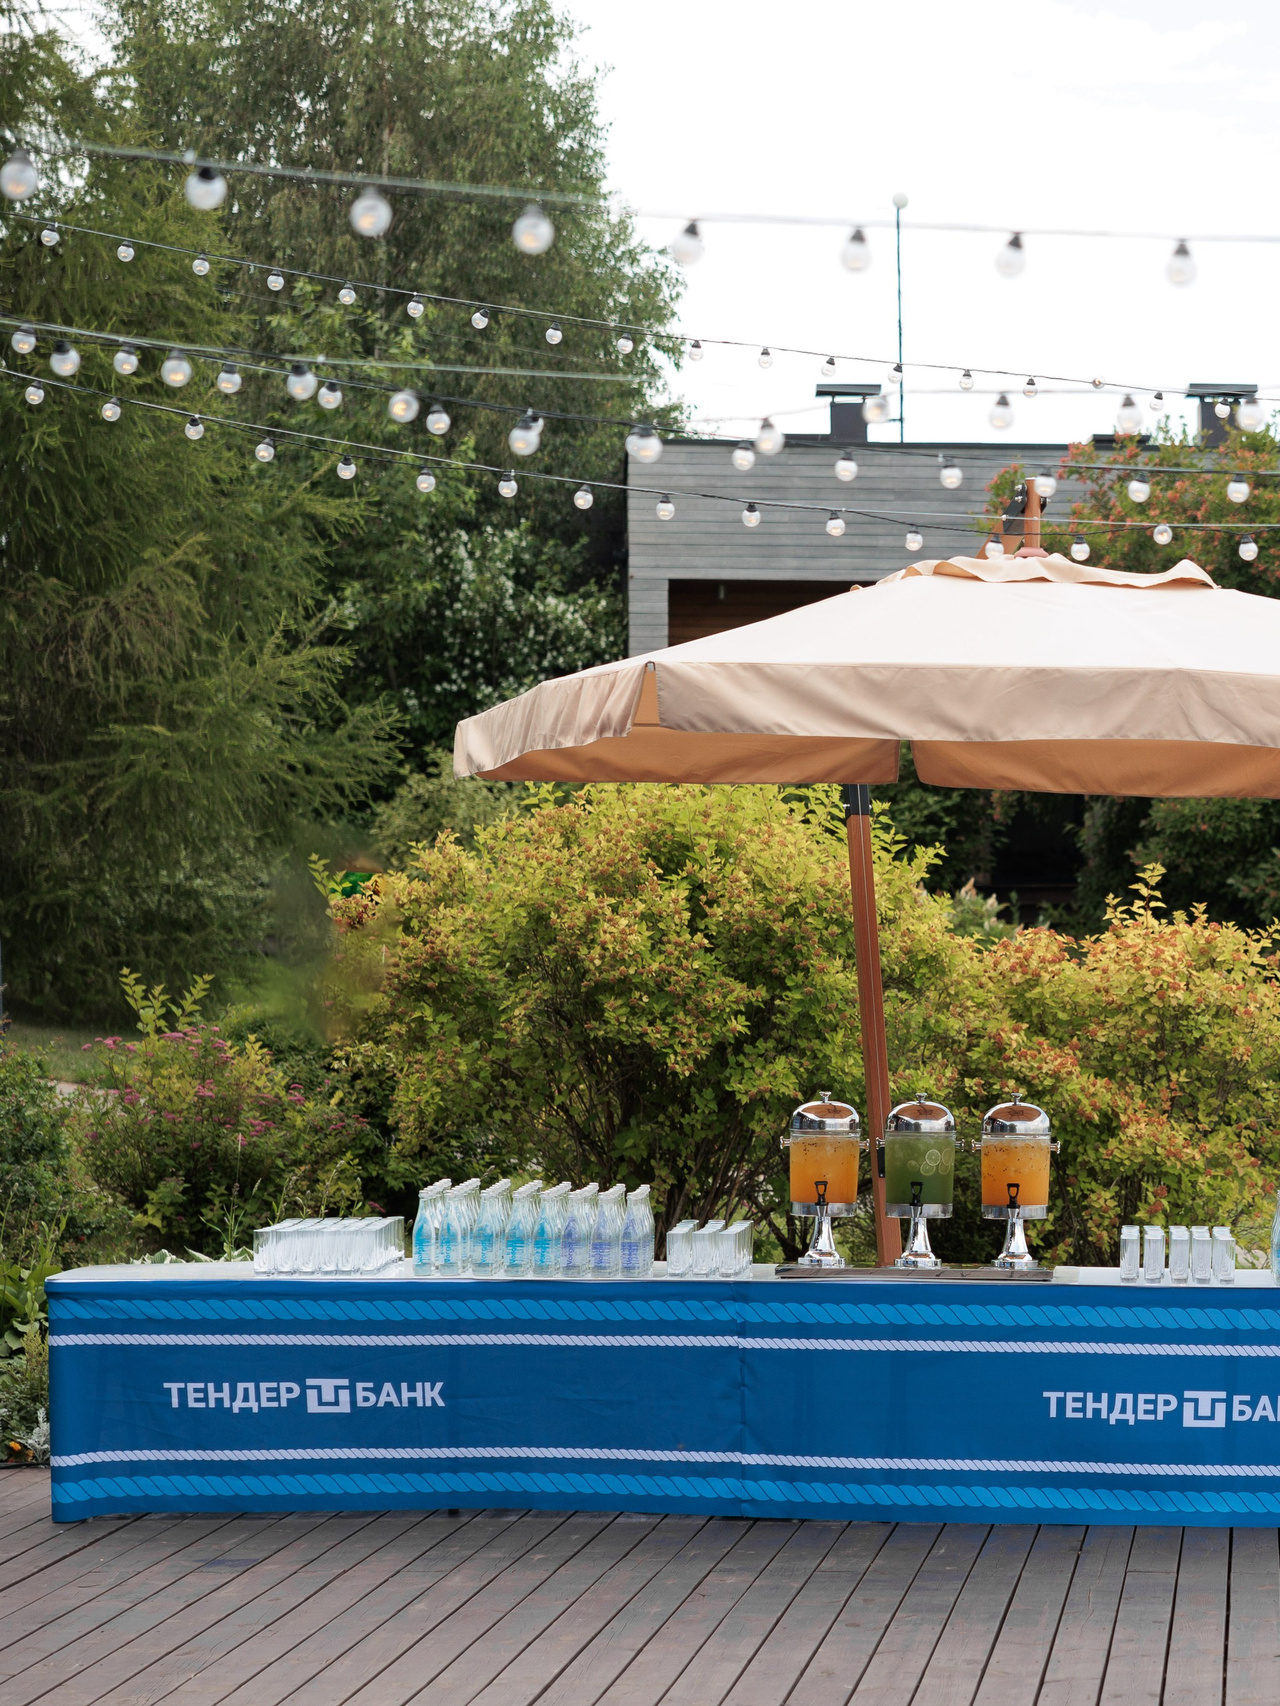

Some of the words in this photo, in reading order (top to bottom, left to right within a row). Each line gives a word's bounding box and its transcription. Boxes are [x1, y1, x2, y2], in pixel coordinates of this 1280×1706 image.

[163, 1382, 301, 1413] ТЕНДЕР
[356, 1382, 446, 1407] БАНК
[1043, 1391, 1178, 1425] ТЕНДЕР
